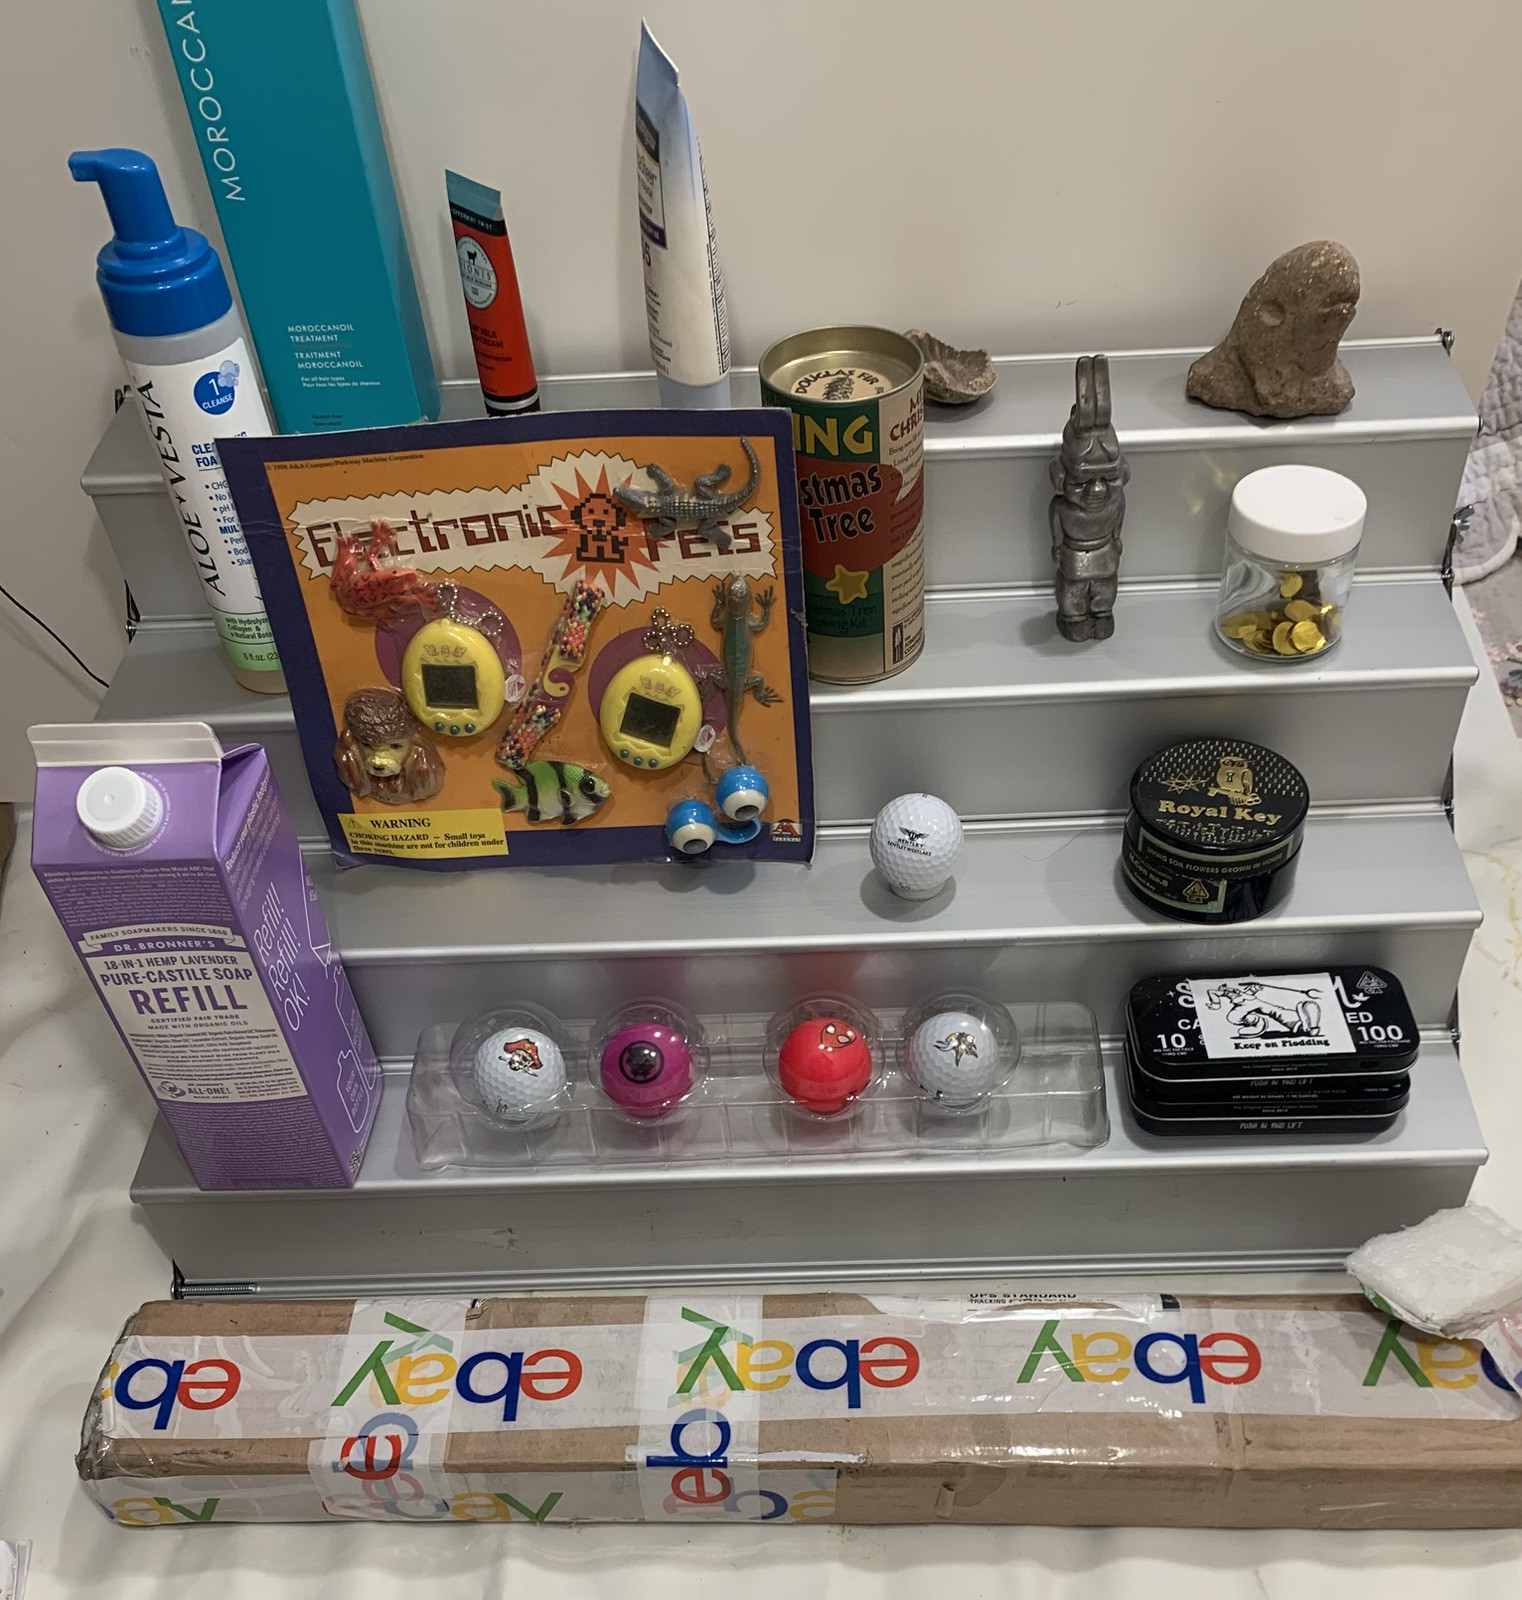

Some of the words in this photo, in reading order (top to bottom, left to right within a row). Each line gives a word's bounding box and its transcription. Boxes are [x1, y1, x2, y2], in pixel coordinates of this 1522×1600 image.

[287, 324, 355, 333] MOROCCANOIL
[290, 334, 339, 343] TREATMENT
[294, 351, 342, 359] TRAITMENT
[297, 361, 364, 369] MOROCCANOIL
[208, 378, 219, 396] 1
[795, 369, 856, 394] DOUGLAS
[857, 371, 880, 386] FIR
[202, 393, 234, 410] CLEANSE
[137, 380, 187, 484] VESTA
[362, 456, 388, 464] Machine
[388, 453, 424, 463] Corporation
[219, 505, 230, 514] pH
[223, 515, 235, 523] For
[807, 507, 877, 543] Tree
[219, 524, 240, 535] MUL
[180, 511, 227, 597] ALOE
[227, 624, 253, 633] Collagen
[1158, 799, 1228, 820] Royal
[1233, 806, 1283, 826] Key
[370, 817, 432, 829] WARNING
[349, 832, 390, 842] CHOKING
[390, 833, 430, 842] HAZARD
[444, 832, 468, 841] Small
[469, 833, 486, 841] toys
[374, 841, 405, 850] machine
[420, 841, 434, 850] not
[434, 841, 446, 850] for
[447, 839, 480, 848] children
[480, 838, 505, 847] under
[897, 838, 925, 848] BENTLEY
[353, 845, 374, 853] three
[1168, 857, 1185, 870] SOIL
[1185, 863, 1220, 874] FLOWERS
[1221, 863, 1253, 874] GROWN
[253, 881, 285, 968] Refill!
[90, 931, 119, 942] FAMILY
[120, 926, 179, 936] SOAPMAKERS
[180, 926, 208, 934] SINCE
[113, 944, 138, 952] DR.
[138, 940, 216, 951] BRONNER'S
[103, 958, 145, 971] 18-IN-1
[145, 956, 178, 968] HEMP
[180, 955, 238, 967] LAVENDER
[268, 917, 302, 1001] Refill!
[99, 967, 211, 987] PURE-CASTILE
[212, 967, 254, 981] SOAP
[129, 984, 248, 1015] REFILL
[284, 972, 311, 1031] OK!
[1156, 1033, 1187, 1049] 10
[1357, 1024, 1404, 1042] 100
[1233, 1041, 1258, 1051] Keep
[1280, 1038, 1331, 1048] Plodding
[187, 1086, 231, 1095] ALL-ONE!
[676, 1326, 921, 1409] ebay
[1016, 1319, 1262, 1404] ebay
[330, 1339, 583, 1422] ebay
[102, 1357, 241, 1430] eb
